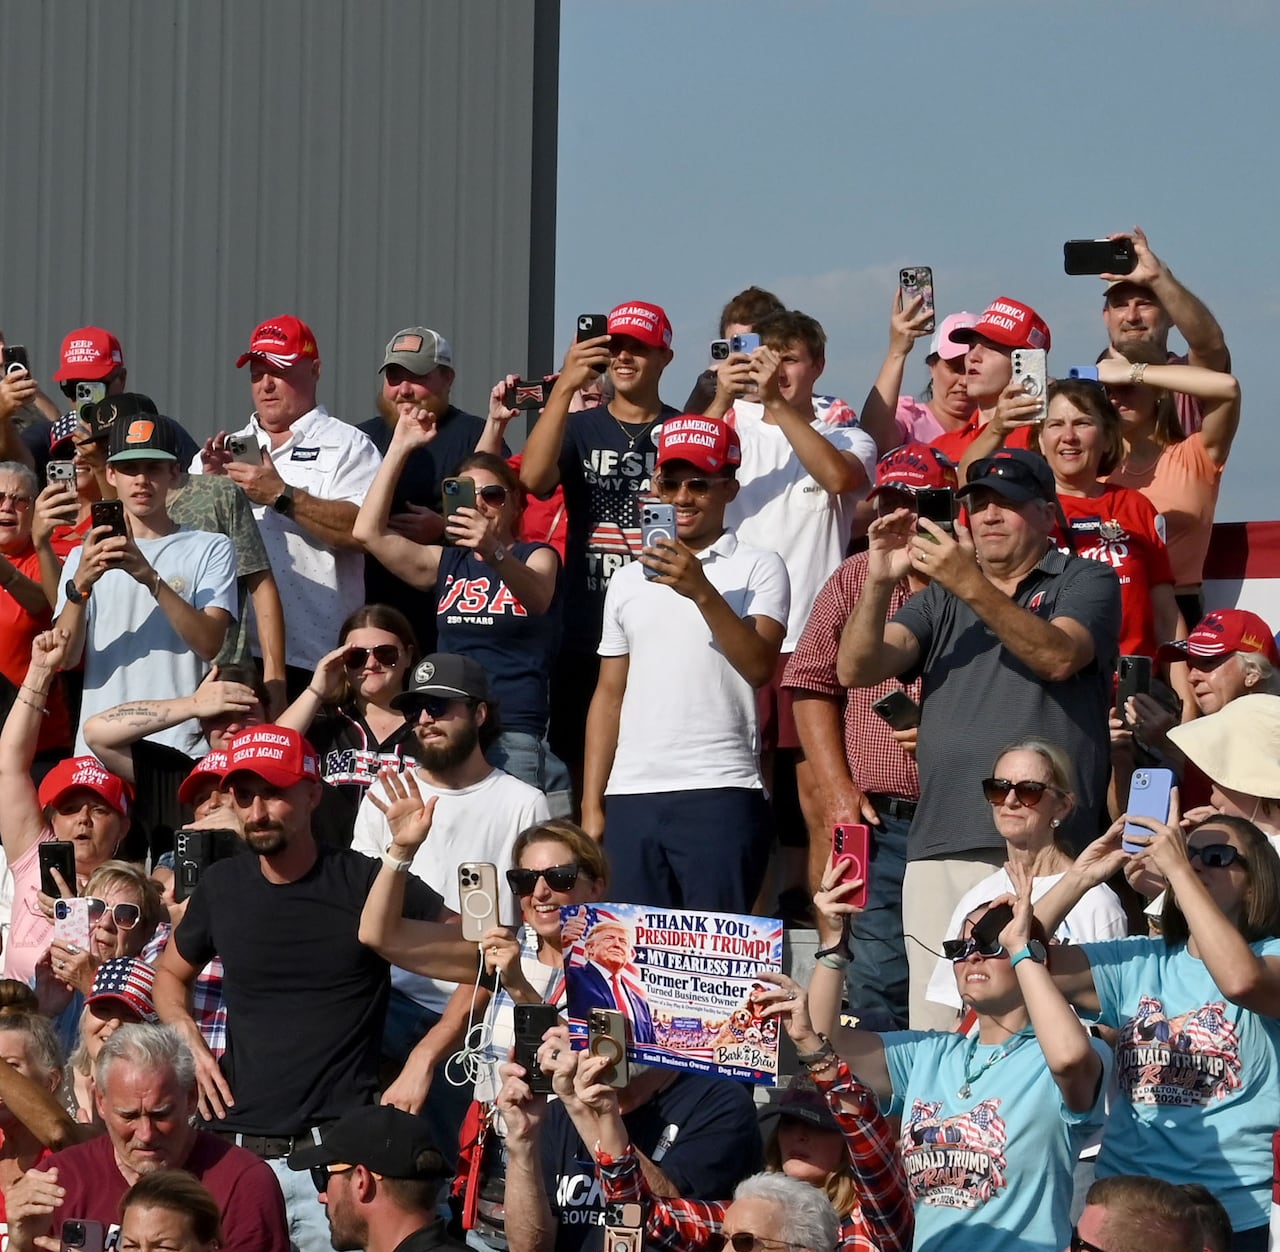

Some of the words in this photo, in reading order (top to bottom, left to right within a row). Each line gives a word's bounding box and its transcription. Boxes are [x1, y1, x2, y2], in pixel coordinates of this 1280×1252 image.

[631, 317, 653, 331] AGAIN
[64, 348, 100, 358] AMERICA
[70, 340, 92, 349] KEEP
[67, 355, 95, 363] GREAT
[126, 420, 155, 444] 9
[663, 422, 682, 435] MAKE
[682, 420, 720, 436] AMERICA
[665, 433, 687, 447] GREAT
[687, 433, 715, 448] AGAIN
[598, 477, 624, 491] MY
[437, 574, 527, 617] USA
[463, 616, 494, 625] YEARS
[232, 734, 251, 750] MAKE
[252, 732, 290, 747] AMERICA
[234, 748, 255, 763] GREAT
[256, 747, 283, 760] AGAIN
[645, 914, 708, 933] THANK
[713, 917, 750, 938] YOU
[635, 926, 708, 949] PRESIDENT
[711, 935, 771, 964] TRUMP!
[647, 949, 666, 966] MY
[667, 952, 729, 976] FEARLESS
[640, 967, 689, 991] Former
[690, 977, 748, 999] Teacher
[646, 984, 673, 998] Turned
[674, 989, 710, 1005] Business
[711, 995, 739, 1008] Owner
[661, 1055, 688, 1066] Business
[688, 1060, 710, 1071] Owner
[718, 1066, 731, 1076] Dog
[732, 1068, 751, 1078] Lover
[718, 1047, 744, 1064] Bark
[751, 1055, 776, 1069] Brew
[1122, 1048, 1171, 1069] DONALD
[1172, 1051, 1225, 1078] TRUMP
[1155, 1094, 1182, 1104] 2026
[904, 1150, 945, 1176] DONALD
[947, 1150, 990, 1175] TRUMP
